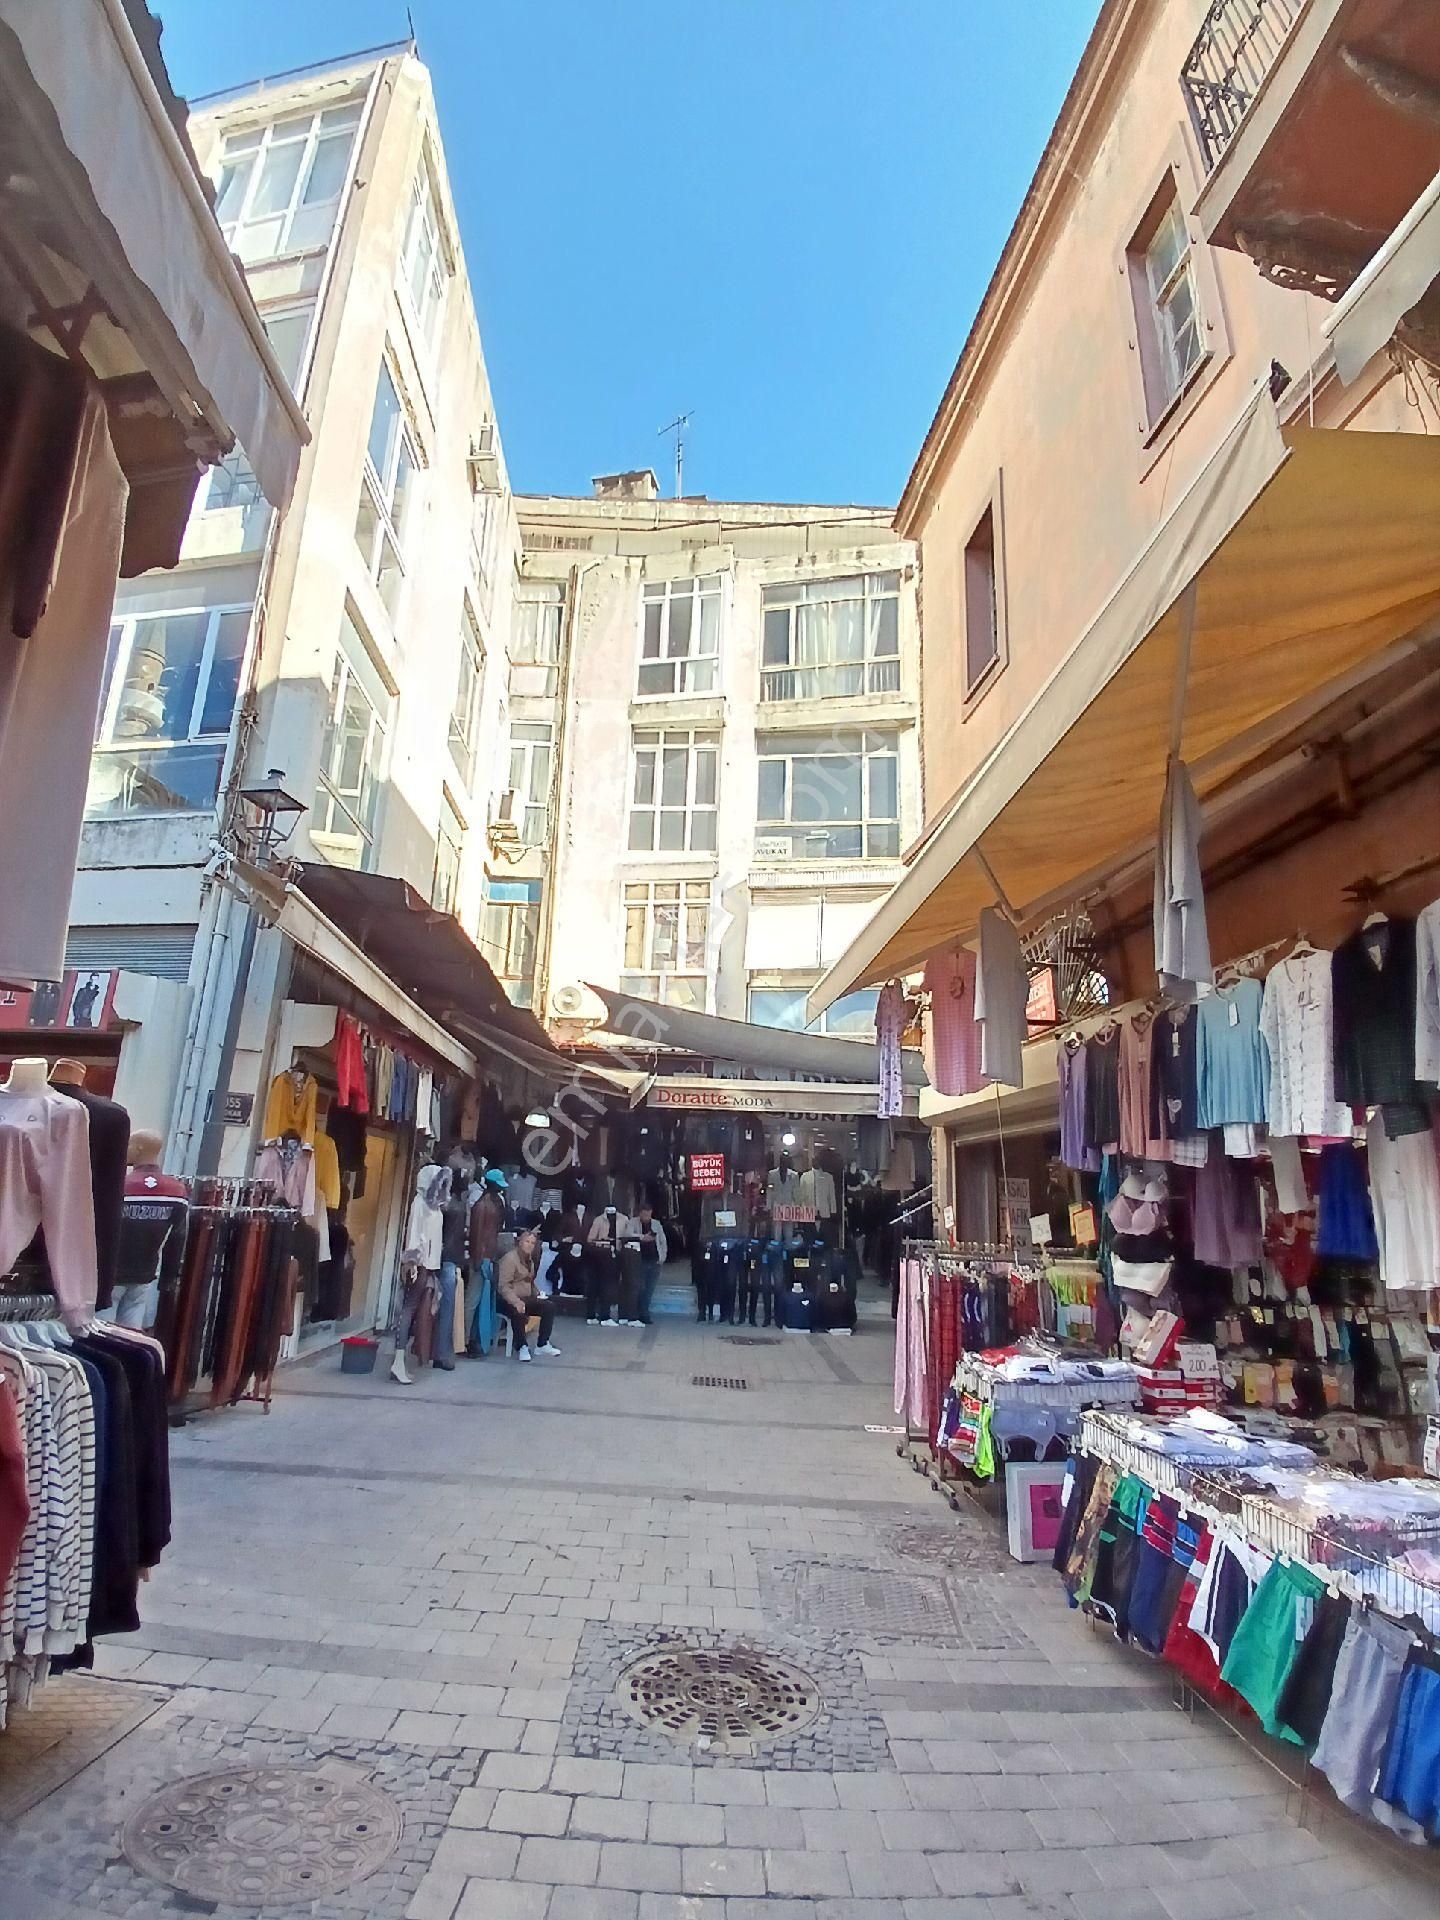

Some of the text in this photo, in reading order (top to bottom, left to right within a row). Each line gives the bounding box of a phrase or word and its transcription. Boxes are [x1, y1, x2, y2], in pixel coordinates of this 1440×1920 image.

[754, 848, 788, 856] AVUKAT
[657, 1089, 774, 1107] Doratte MODA
[692, 1158, 722, 1168] BÜYÜK
[693, 1168, 721, 1178] BEDEN
[692, 1178, 722, 1187] BULUNUR
